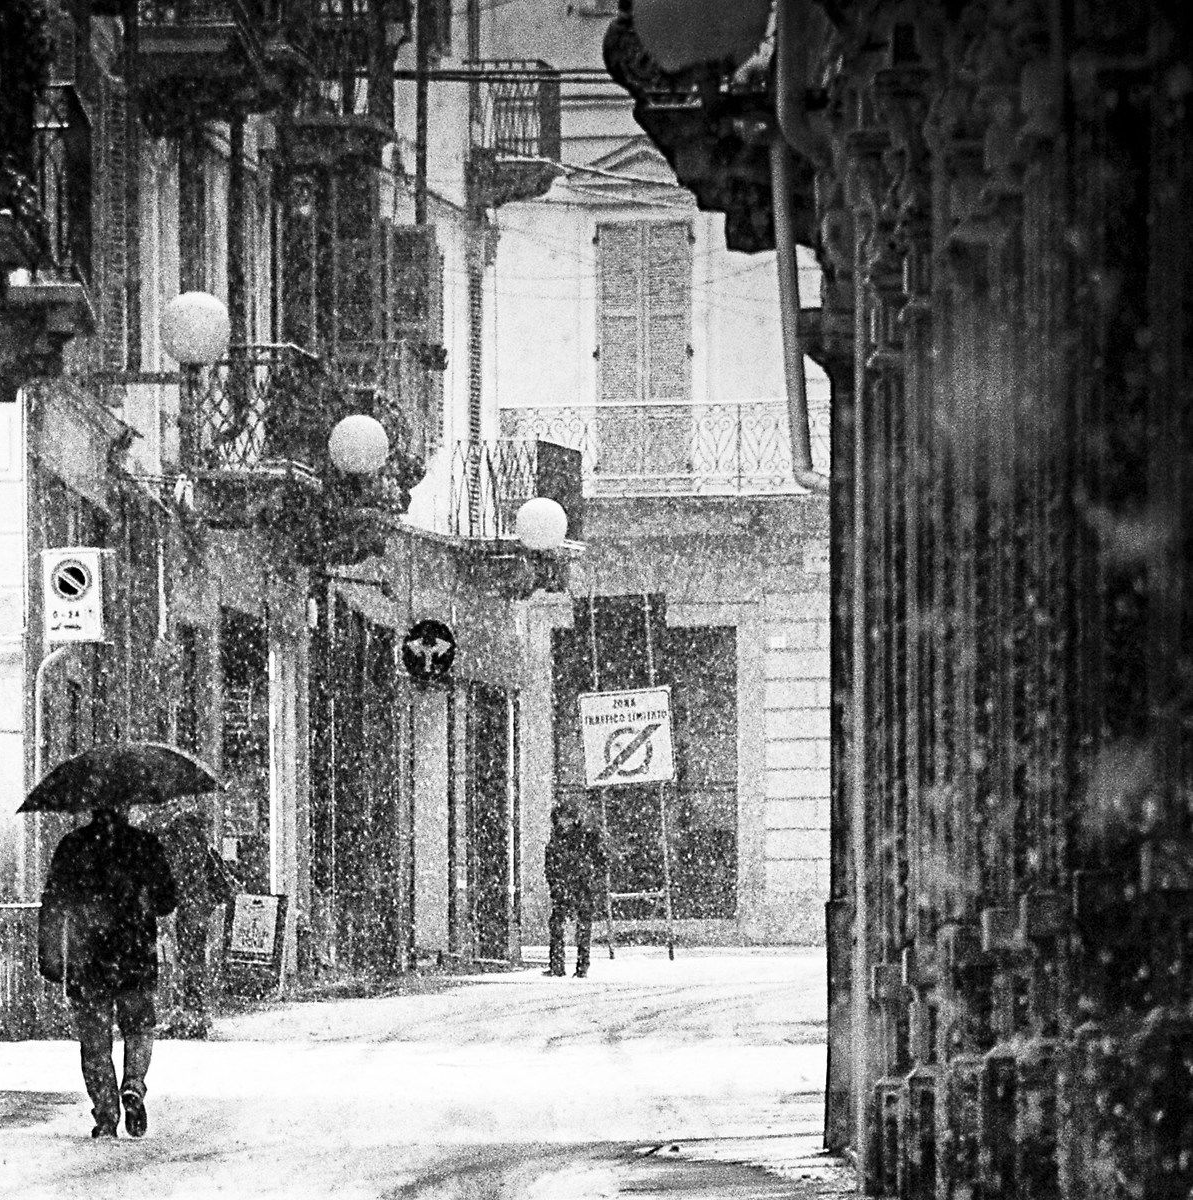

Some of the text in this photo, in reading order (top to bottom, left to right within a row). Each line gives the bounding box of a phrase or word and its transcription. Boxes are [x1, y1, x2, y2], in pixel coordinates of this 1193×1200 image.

[612, 698, 636, 709] ZONA
[584, 710, 668, 725] TRAFFICO LIMITATO
